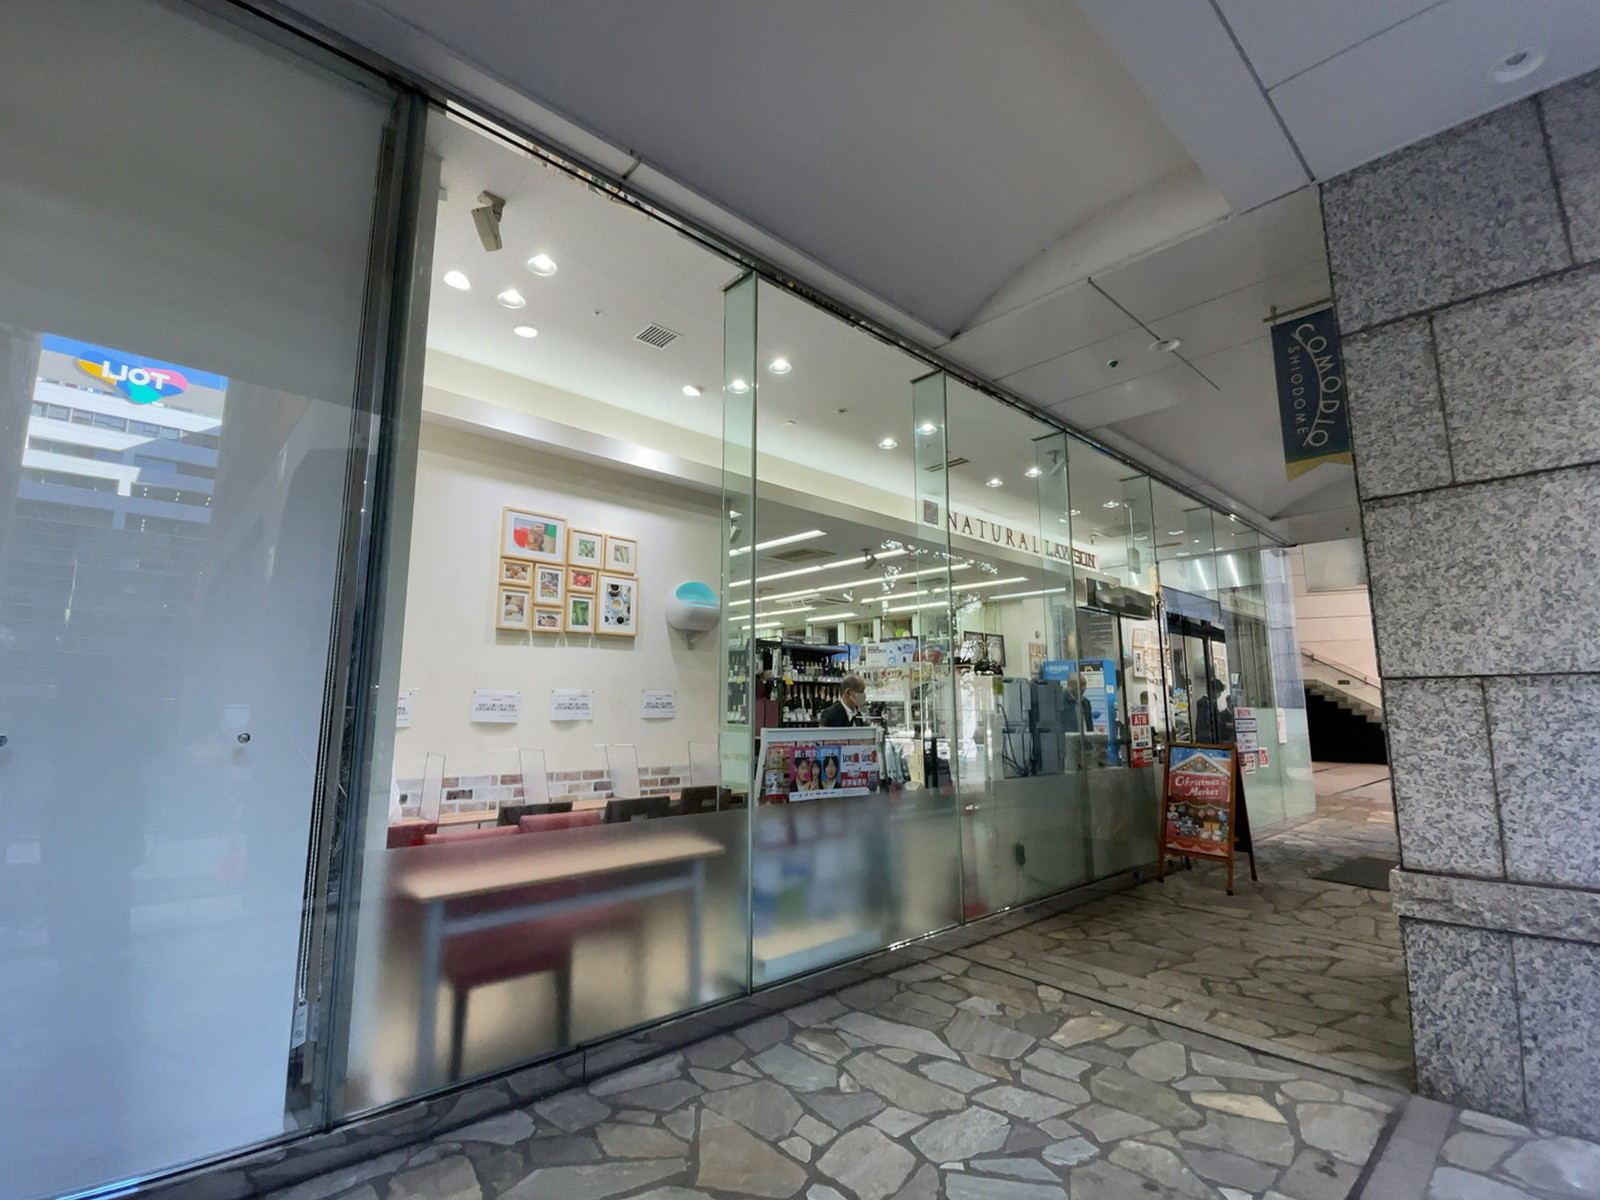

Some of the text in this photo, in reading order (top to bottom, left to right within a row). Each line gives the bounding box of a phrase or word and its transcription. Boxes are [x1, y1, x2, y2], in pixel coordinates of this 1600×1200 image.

[1288, 345, 1309, 434] SHIODOME
[1291, 323, 1341, 447] COMODIO
[948, 512, 1040, 554] NATURAL
[1133, 714, 1148, 725] ATM
[1174, 775, 1220, 787] Christmas
[1184, 786, 1219, 797] Market
